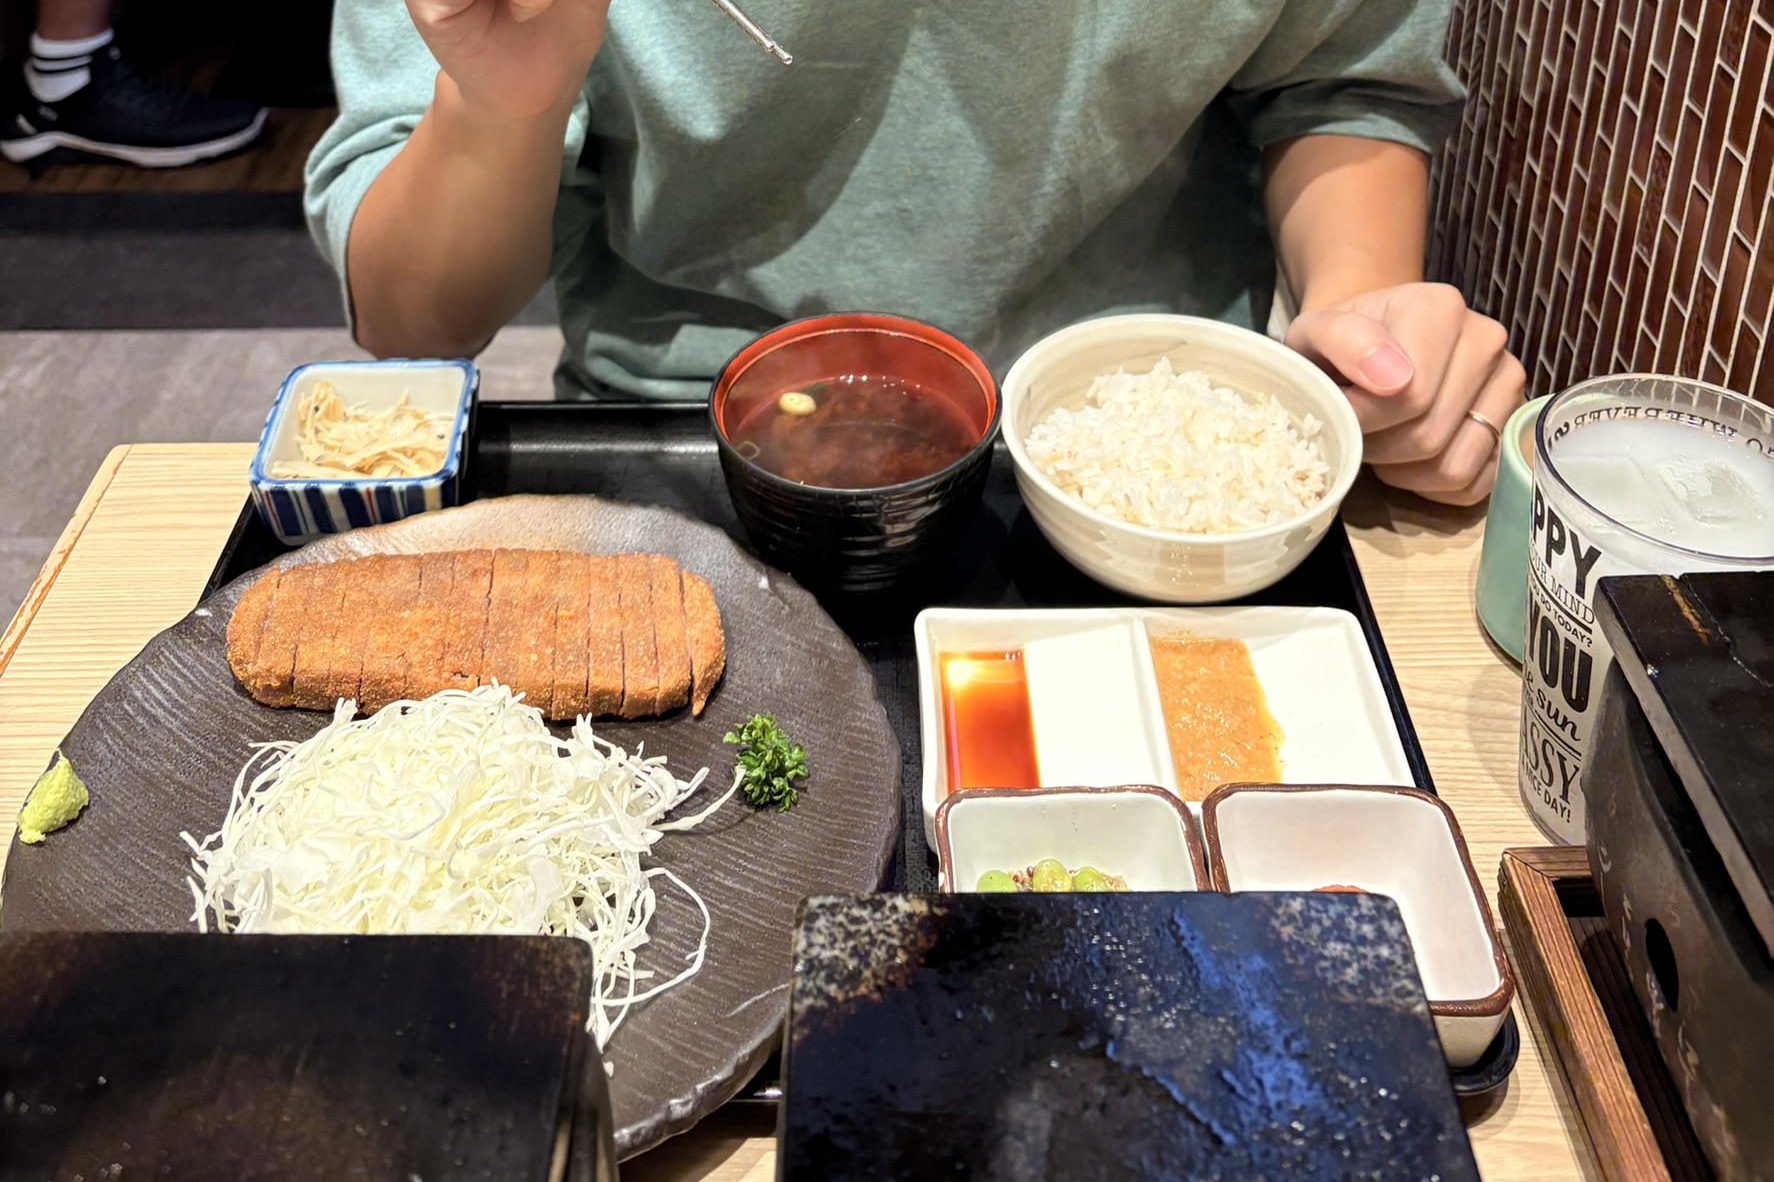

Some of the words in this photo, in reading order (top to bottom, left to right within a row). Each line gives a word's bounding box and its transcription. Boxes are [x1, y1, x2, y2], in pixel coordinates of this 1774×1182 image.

[1531, 483, 1602, 601] PPY
[1551, 574, 1595, 625] MIND
[1529, 586, 1593, 713] YOU
[1553, 608, 1593, 647] TODAY?
[1536, 688, 1581, 741] sun
[1544, 788, 1571, 823] DAY!
